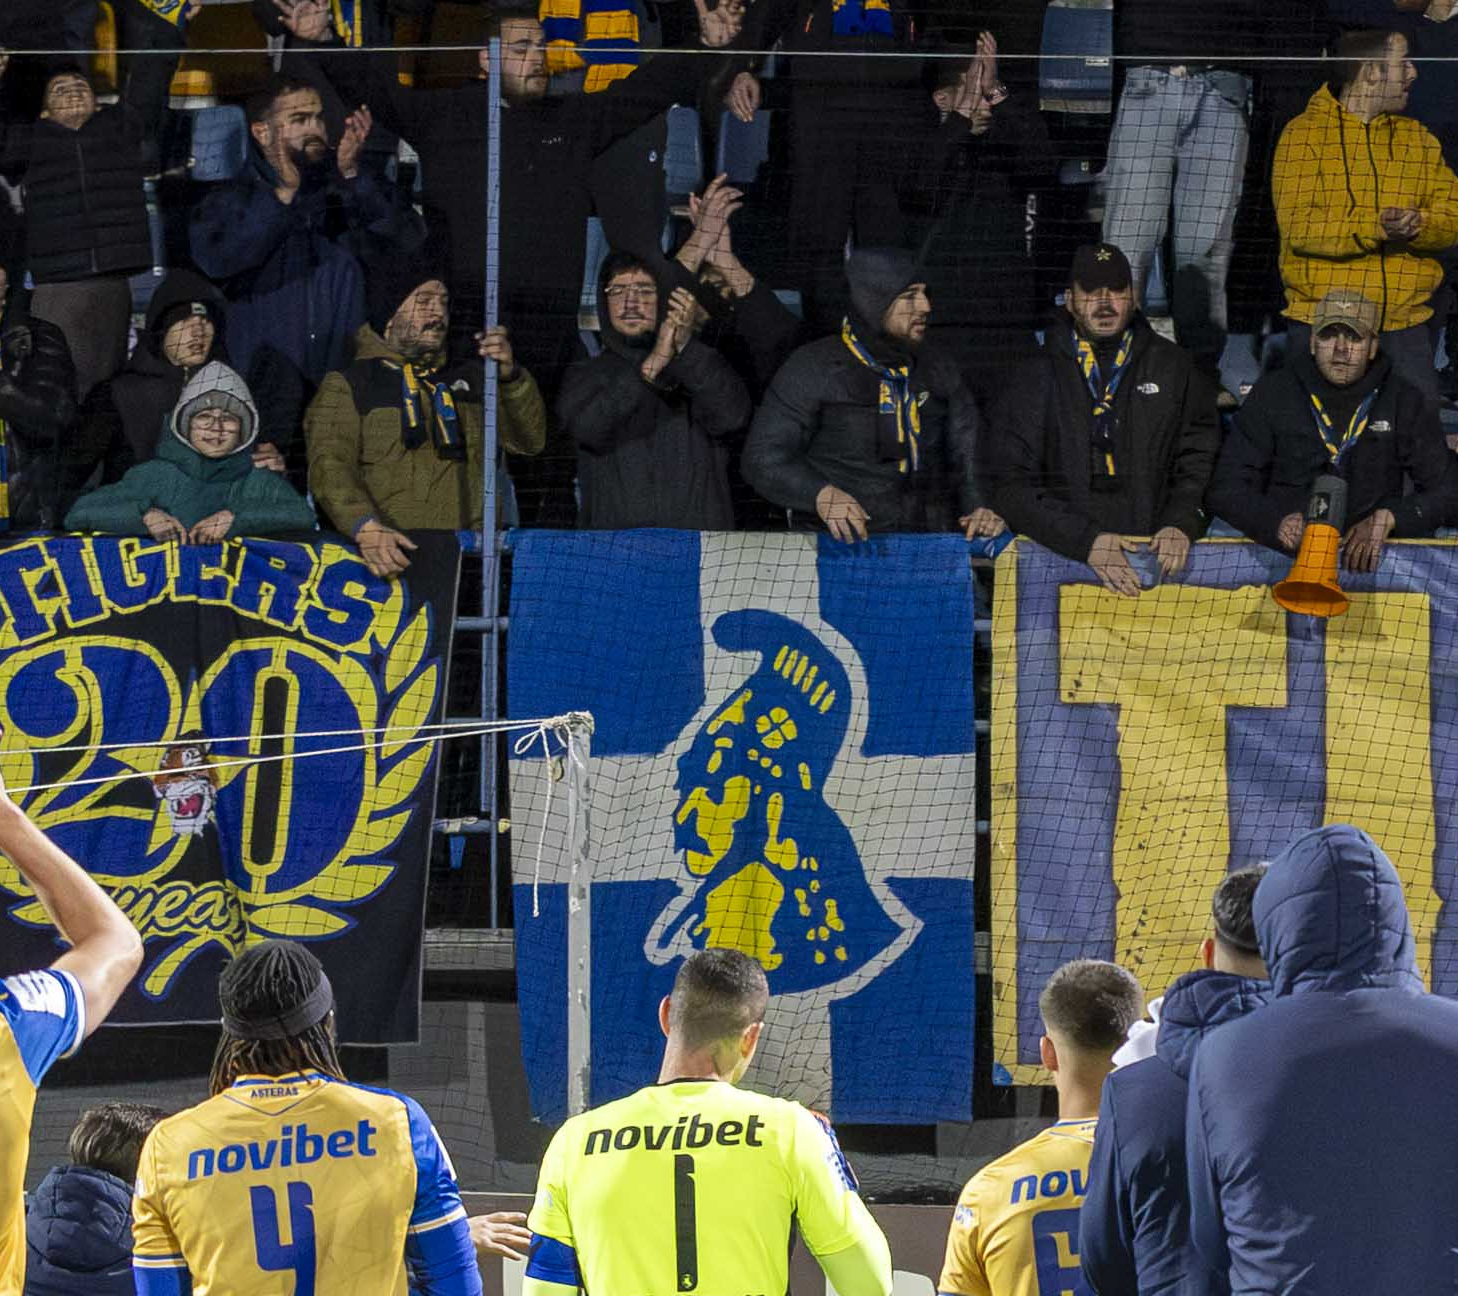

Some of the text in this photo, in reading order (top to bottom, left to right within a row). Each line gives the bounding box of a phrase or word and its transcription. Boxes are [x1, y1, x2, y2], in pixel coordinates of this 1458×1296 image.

[249, 1087, 299, 1099] ASTERAS
[188, 1119, 378, 1182] novibet
[584, 1113, 765, 1156] novibet
[673, 1154, 698, 1293] 1
